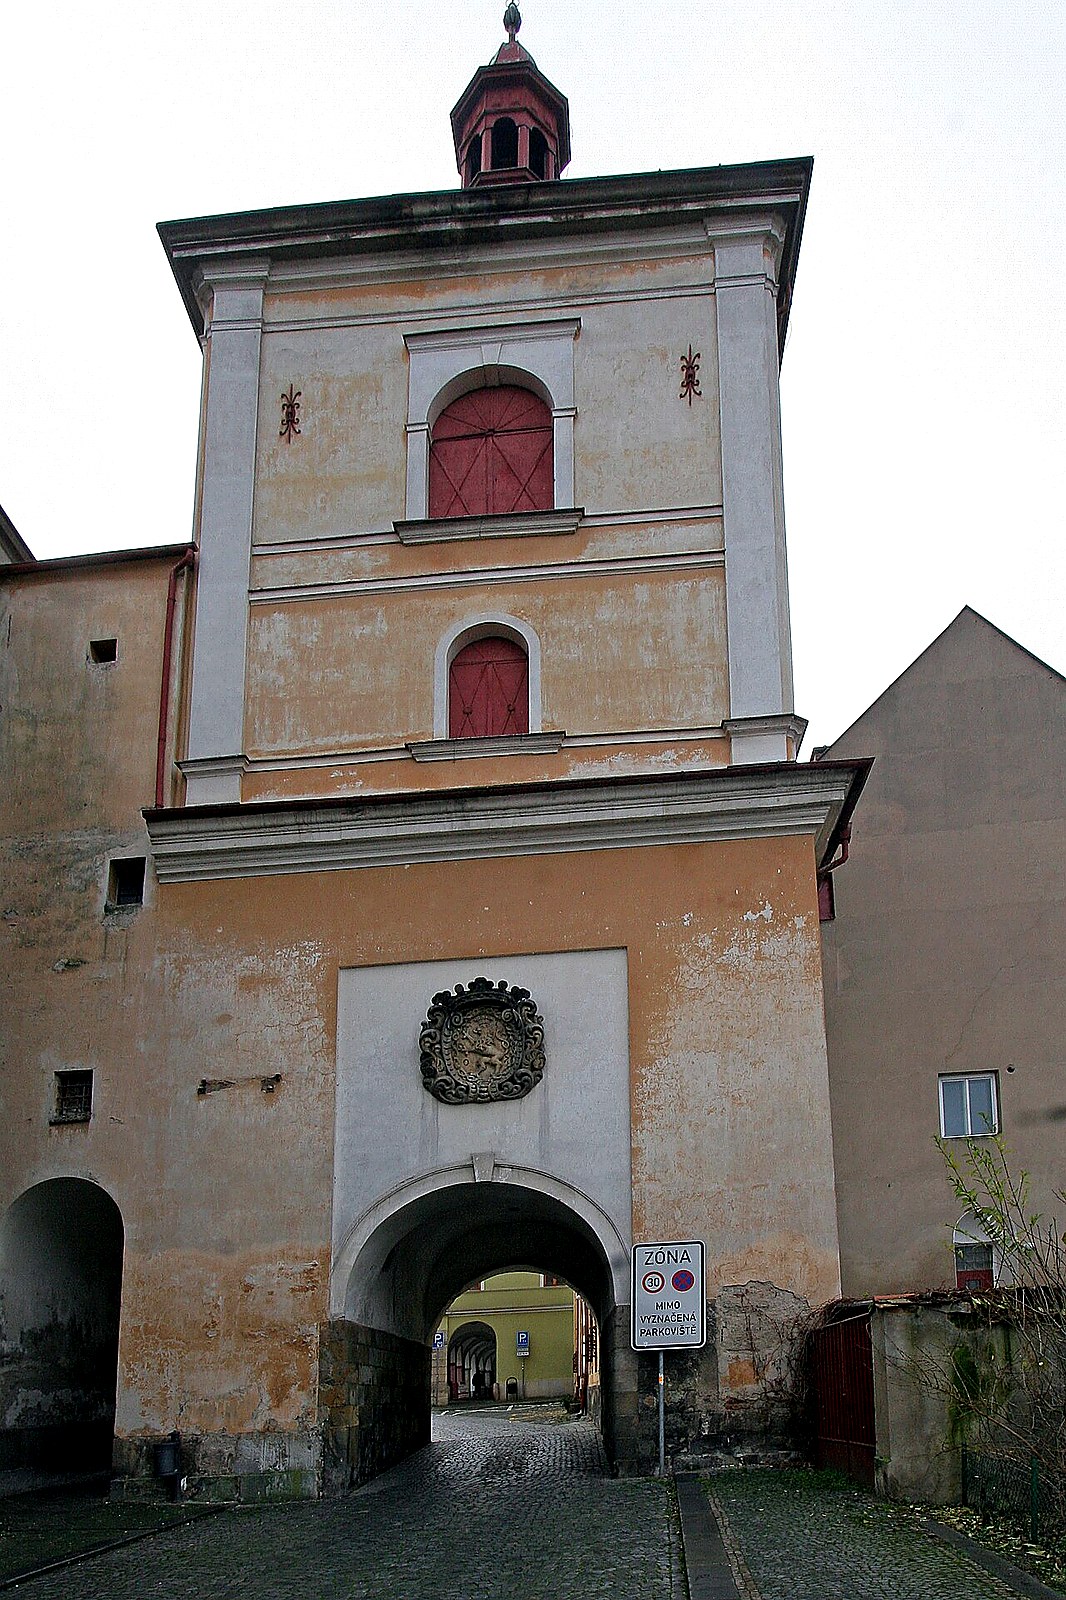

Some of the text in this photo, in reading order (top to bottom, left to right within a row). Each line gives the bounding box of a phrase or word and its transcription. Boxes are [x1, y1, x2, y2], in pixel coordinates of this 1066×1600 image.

[644, 1247, 691, 1265] ZÓNA
[647, 1277, 660, 1287] 30
[655, 1301, 680, 1310] MIMO
[640, 1311, 696, 1323] VYZNAČENÁ
[640, 1325, 696, 1337] PARKOVIŠTĚ
[434, 1333, 442, 1343] P
[519, 1333, 527, 1343] P
